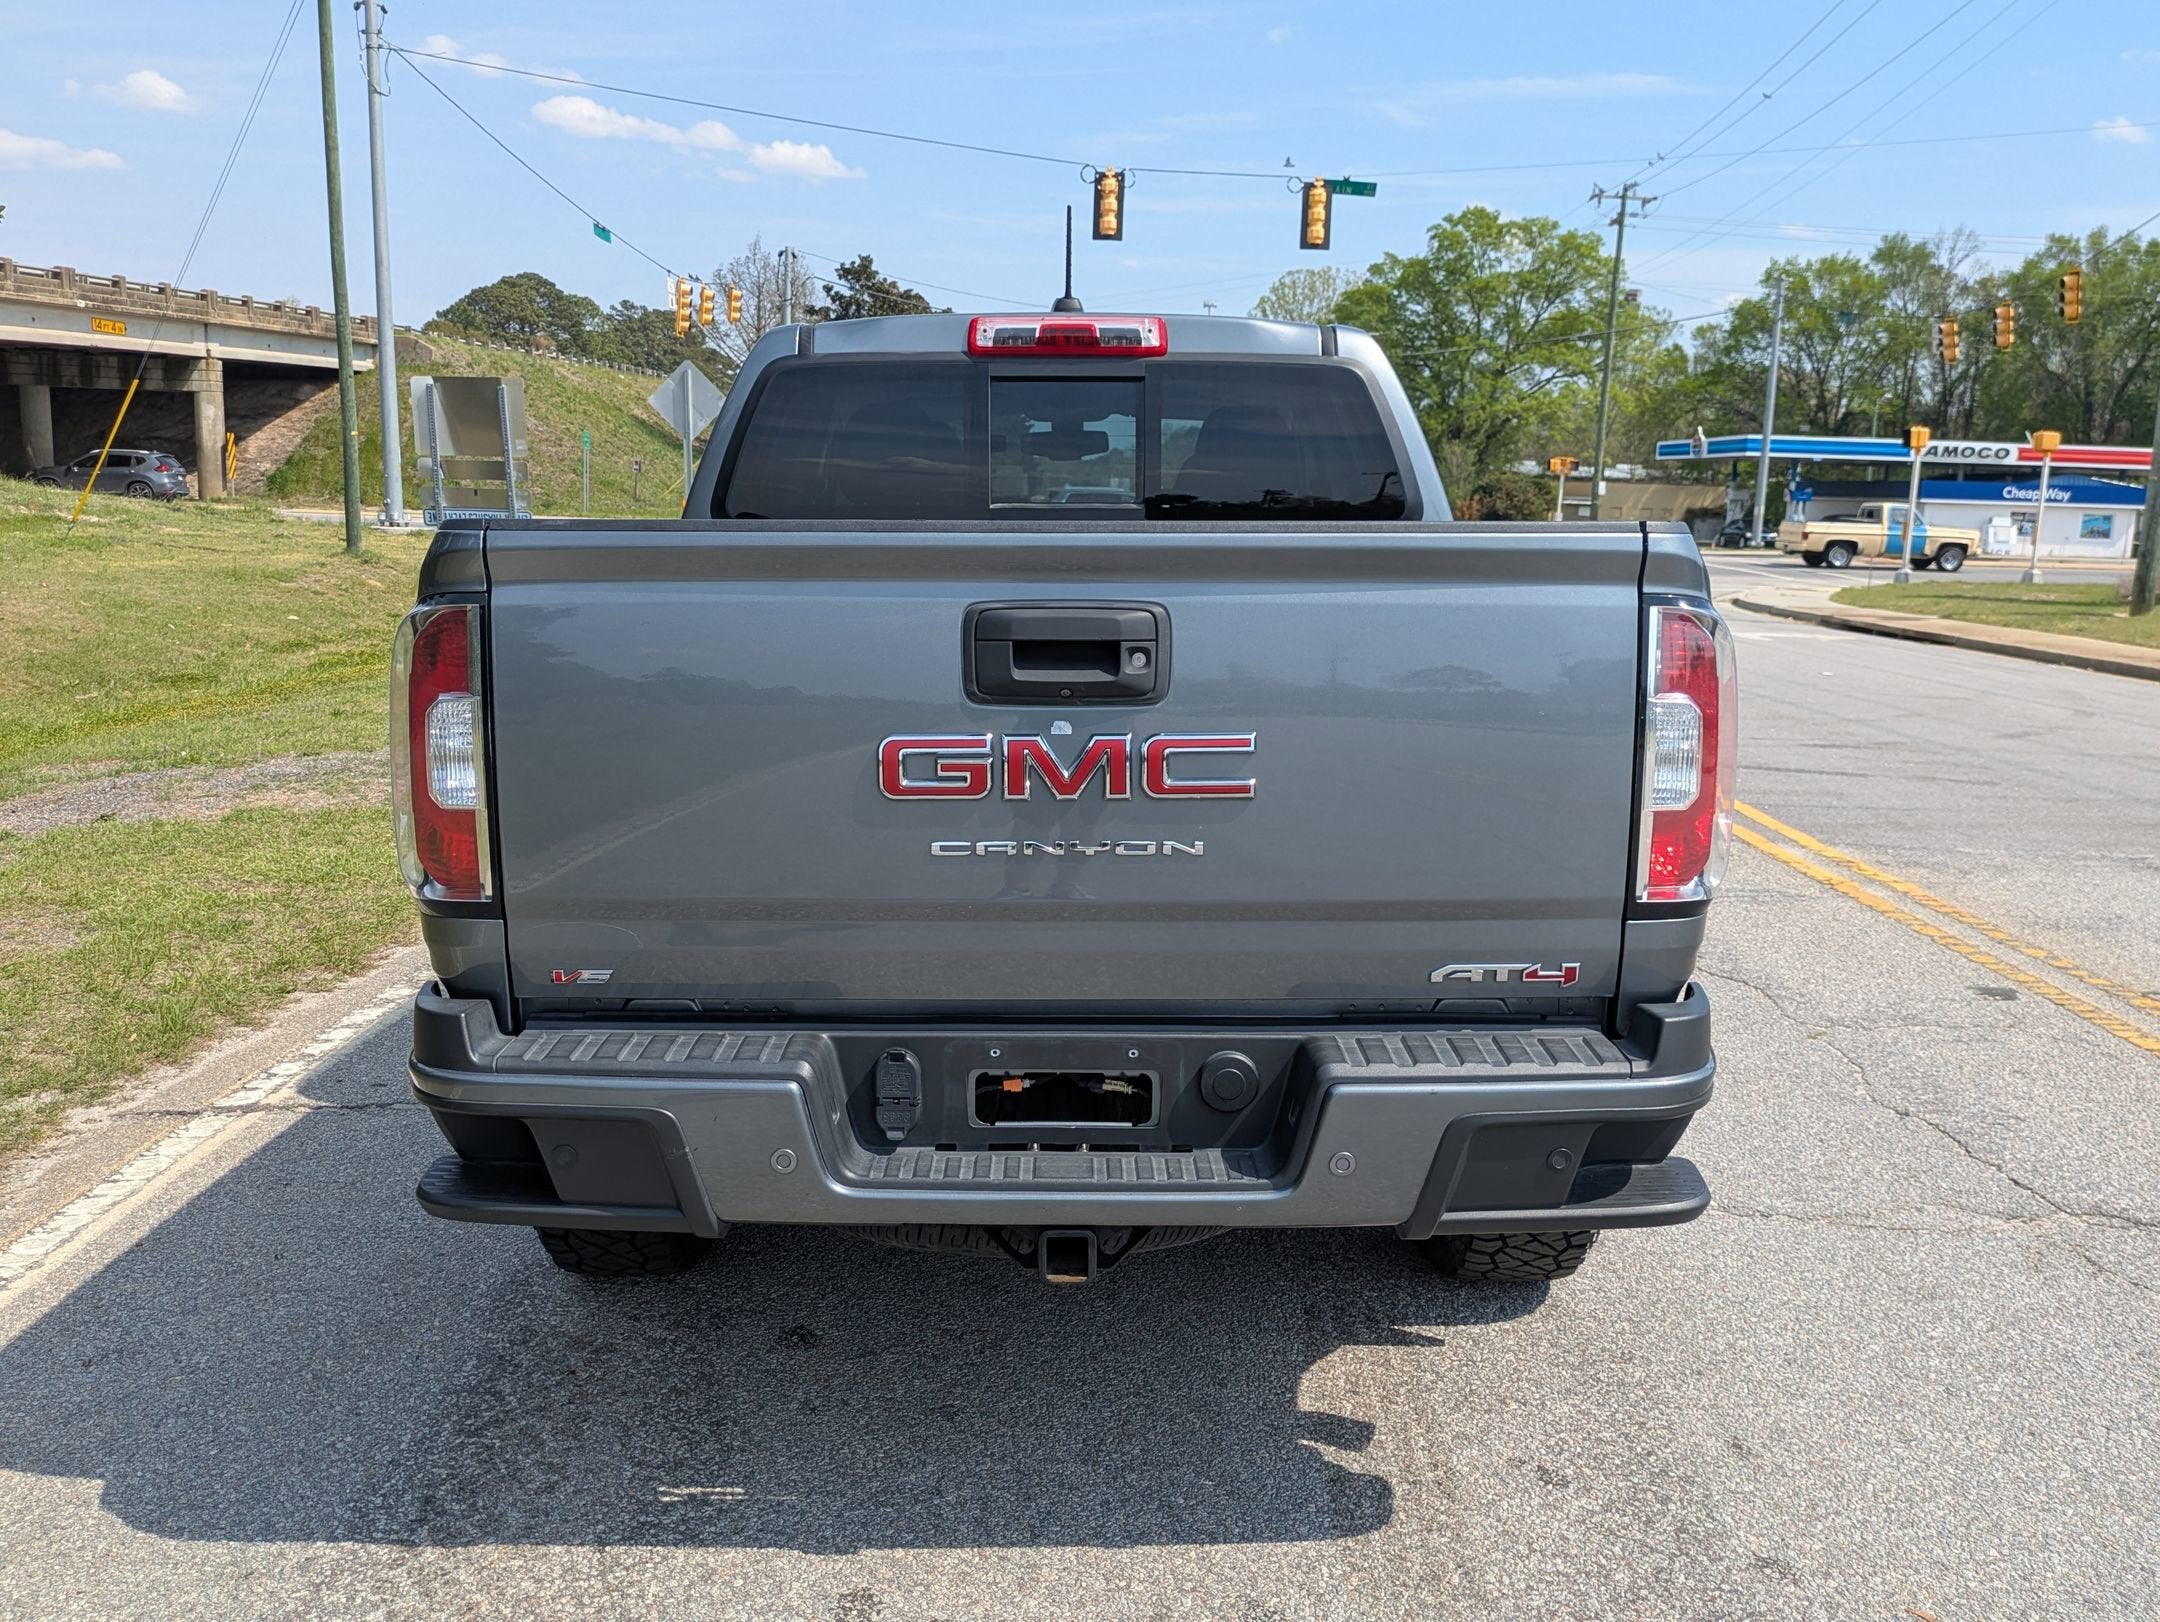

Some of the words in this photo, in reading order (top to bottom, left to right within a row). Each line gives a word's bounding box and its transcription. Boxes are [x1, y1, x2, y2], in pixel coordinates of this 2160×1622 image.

[111, 321, 117, 332] 4
[1924, 445, 2010, 460] AMOCO
[878, 732, 1257, 801] GMC
[930, 840, 1204, 857] CANYON
[552, 969, 613, 984] V6
[1430, 963, 1581, 988] AT4
